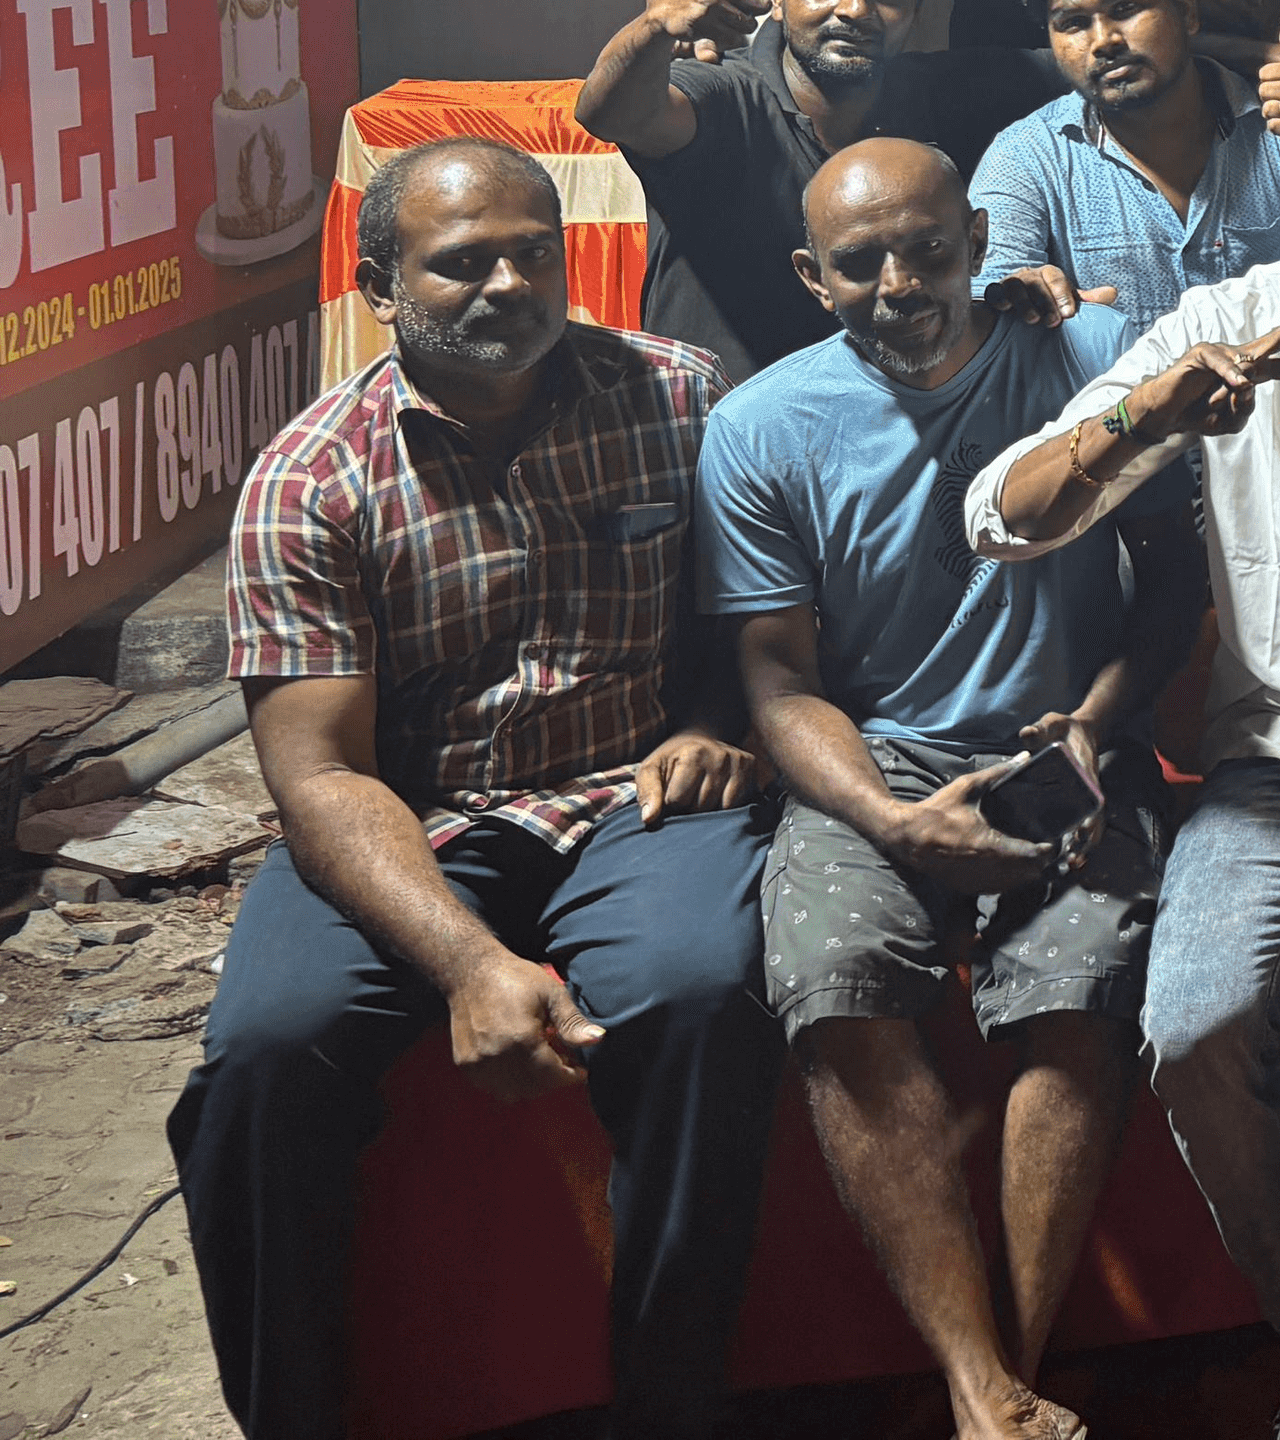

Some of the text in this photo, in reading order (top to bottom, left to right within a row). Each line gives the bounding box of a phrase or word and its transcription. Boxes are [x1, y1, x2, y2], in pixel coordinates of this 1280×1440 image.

[88, 256, 182, 330] 01.01.2025
[53, 396, 120, 578] 407
[154, 344, 242, 523] 8940
